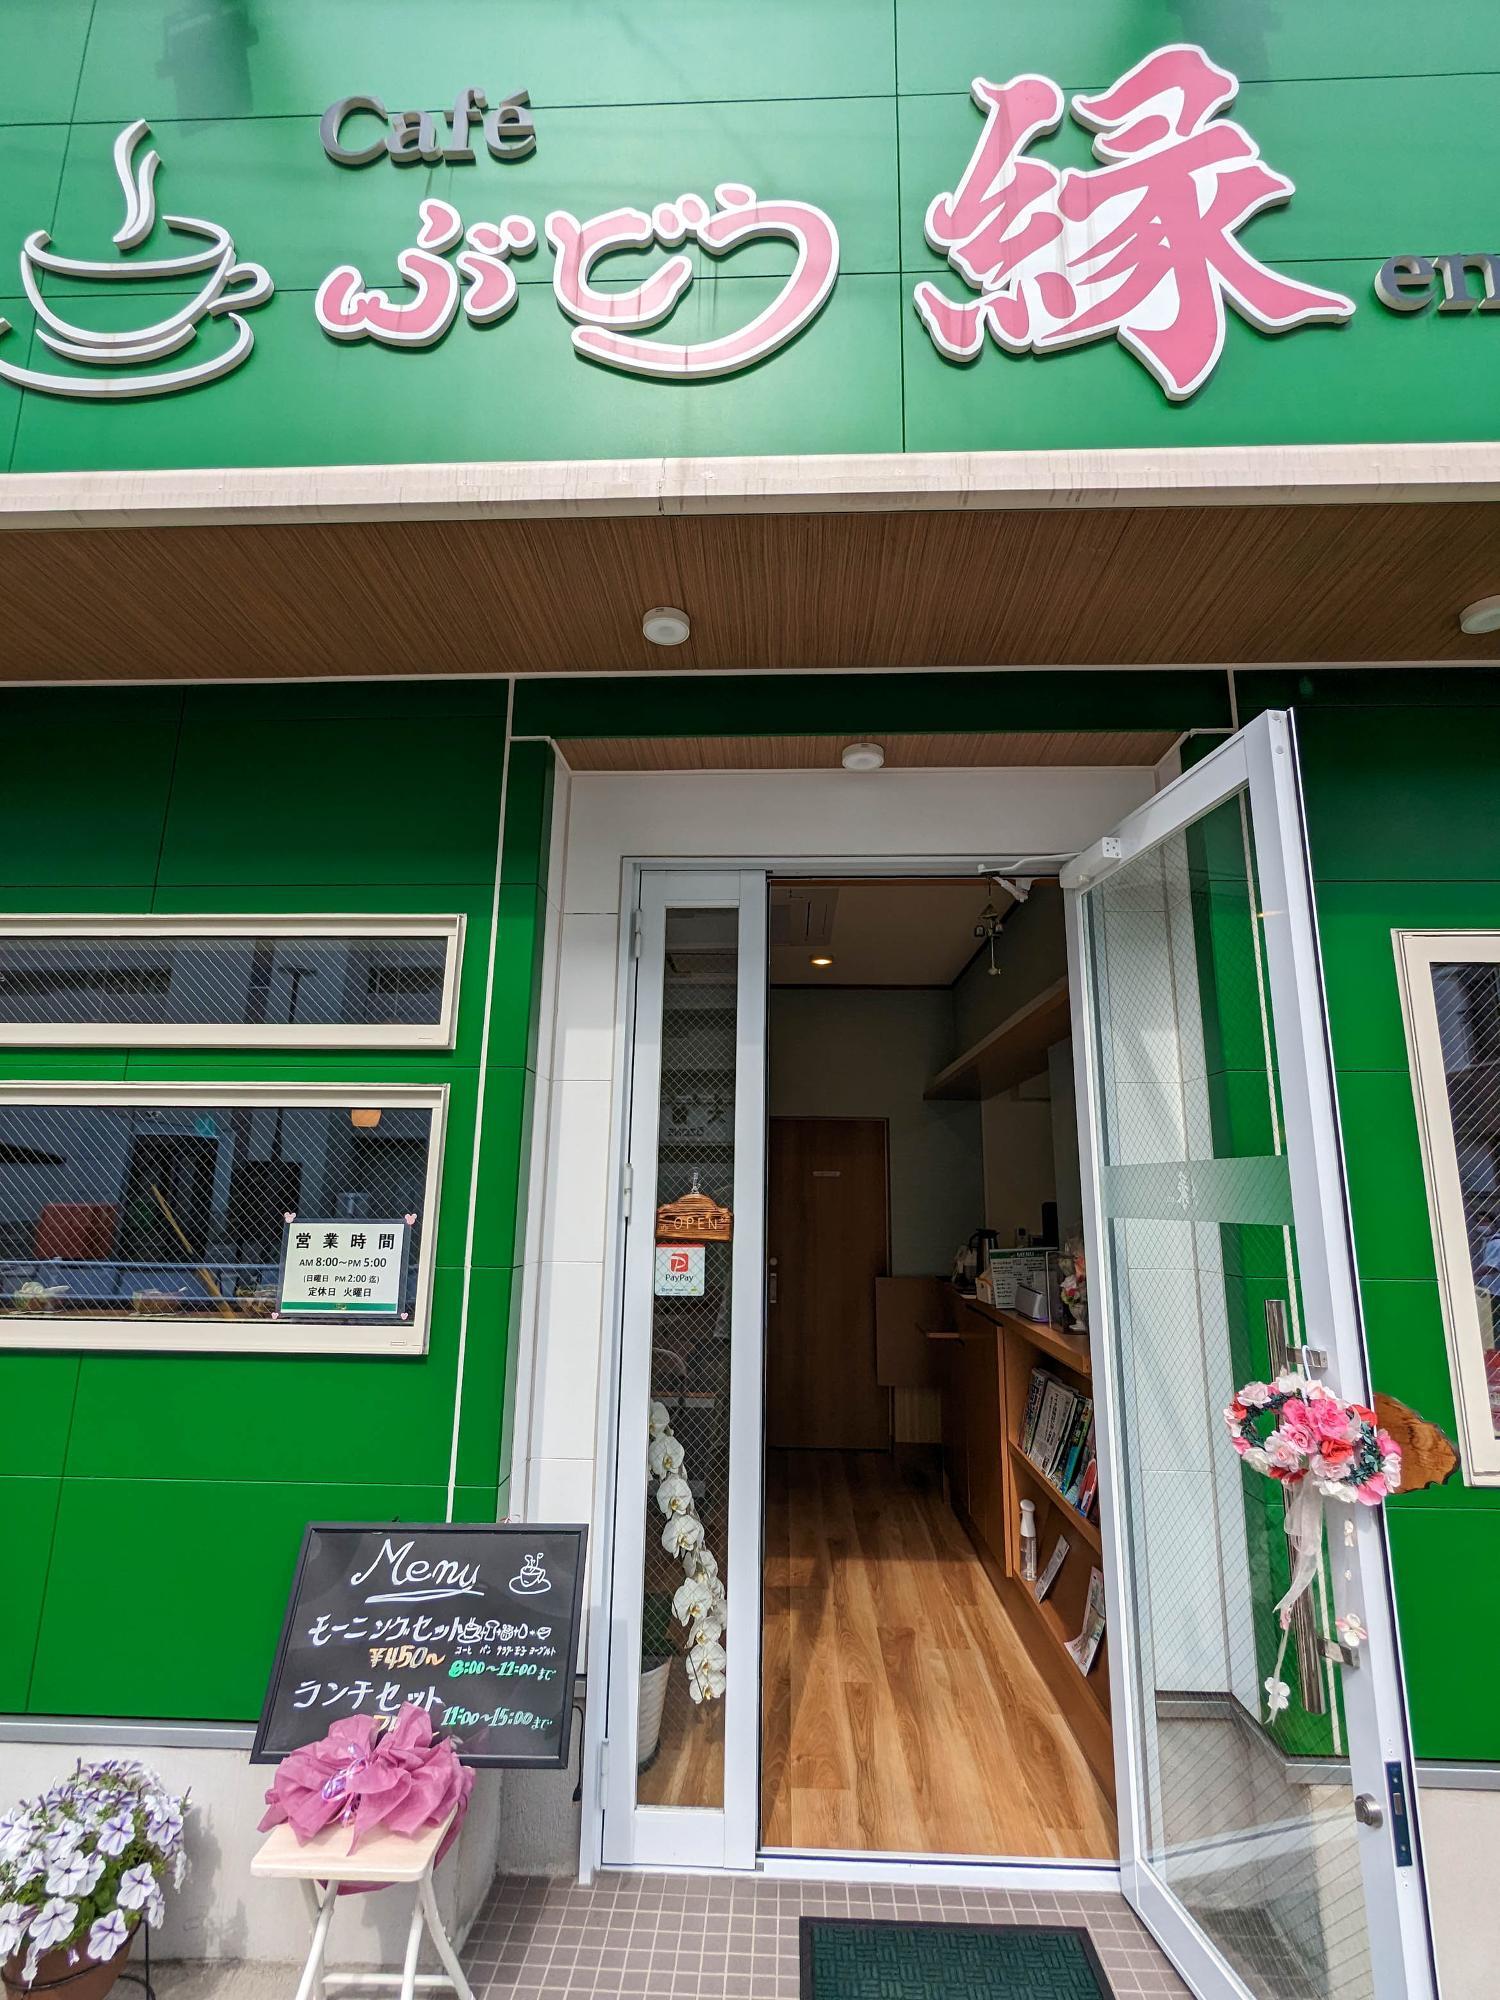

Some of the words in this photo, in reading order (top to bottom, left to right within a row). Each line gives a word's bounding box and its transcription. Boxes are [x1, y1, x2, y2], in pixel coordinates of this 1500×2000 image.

[320, 87, 537, 166] Café
[314, 183, 841, 380] ぶどう
[913, 43, 1357, 402] 縁
[673, 1216, 718, 1230] OPEN
[295, 1232, 395, 1250] 営業時間
[299, 1259, 314, 1267] AM
[363, 1258, 387, 1268] 5:00
[347, 1275, 367, 1283] 2:00
[665, 1274, 694, 1283] PayPay
[308, 1287, 336, 1297] 定休日
[343, 1288, 372, 1297] 火曜日
[350, 1538, 480, 1591] Menu
[307, 1613, 463, 1646] モーニングセット
[479, 1644, 492, 1655] パン
[528, 1645, 556, 1656] ヨーグルト
[293, 1680, 446, 1712] ランチセット
